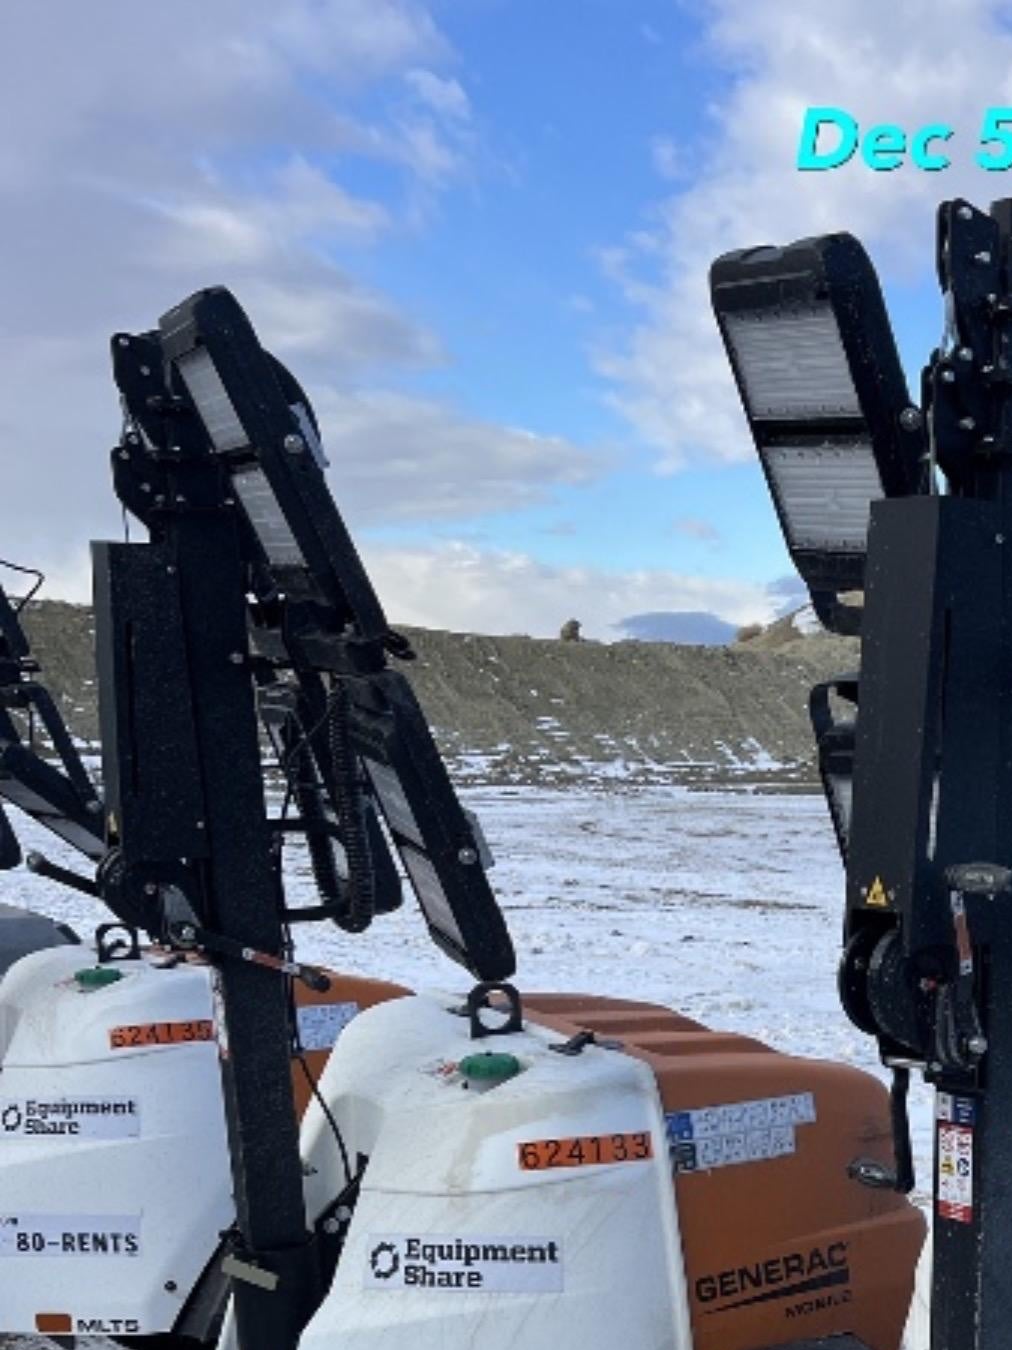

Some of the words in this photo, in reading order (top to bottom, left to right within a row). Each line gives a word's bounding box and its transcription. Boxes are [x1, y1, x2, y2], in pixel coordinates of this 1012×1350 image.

[25, 1099, 138, 1119] Equipment
[24, 1119, 80, 1135] Share
[520, 1133, 650, 1170] 624133
[404, 1238, 559, 1266] Equipment
[404, 1265, 483, 1288] Share
[695, 1241, 849, 1302] GENERAC
[76, 1318, 139, 1333] MLTS
